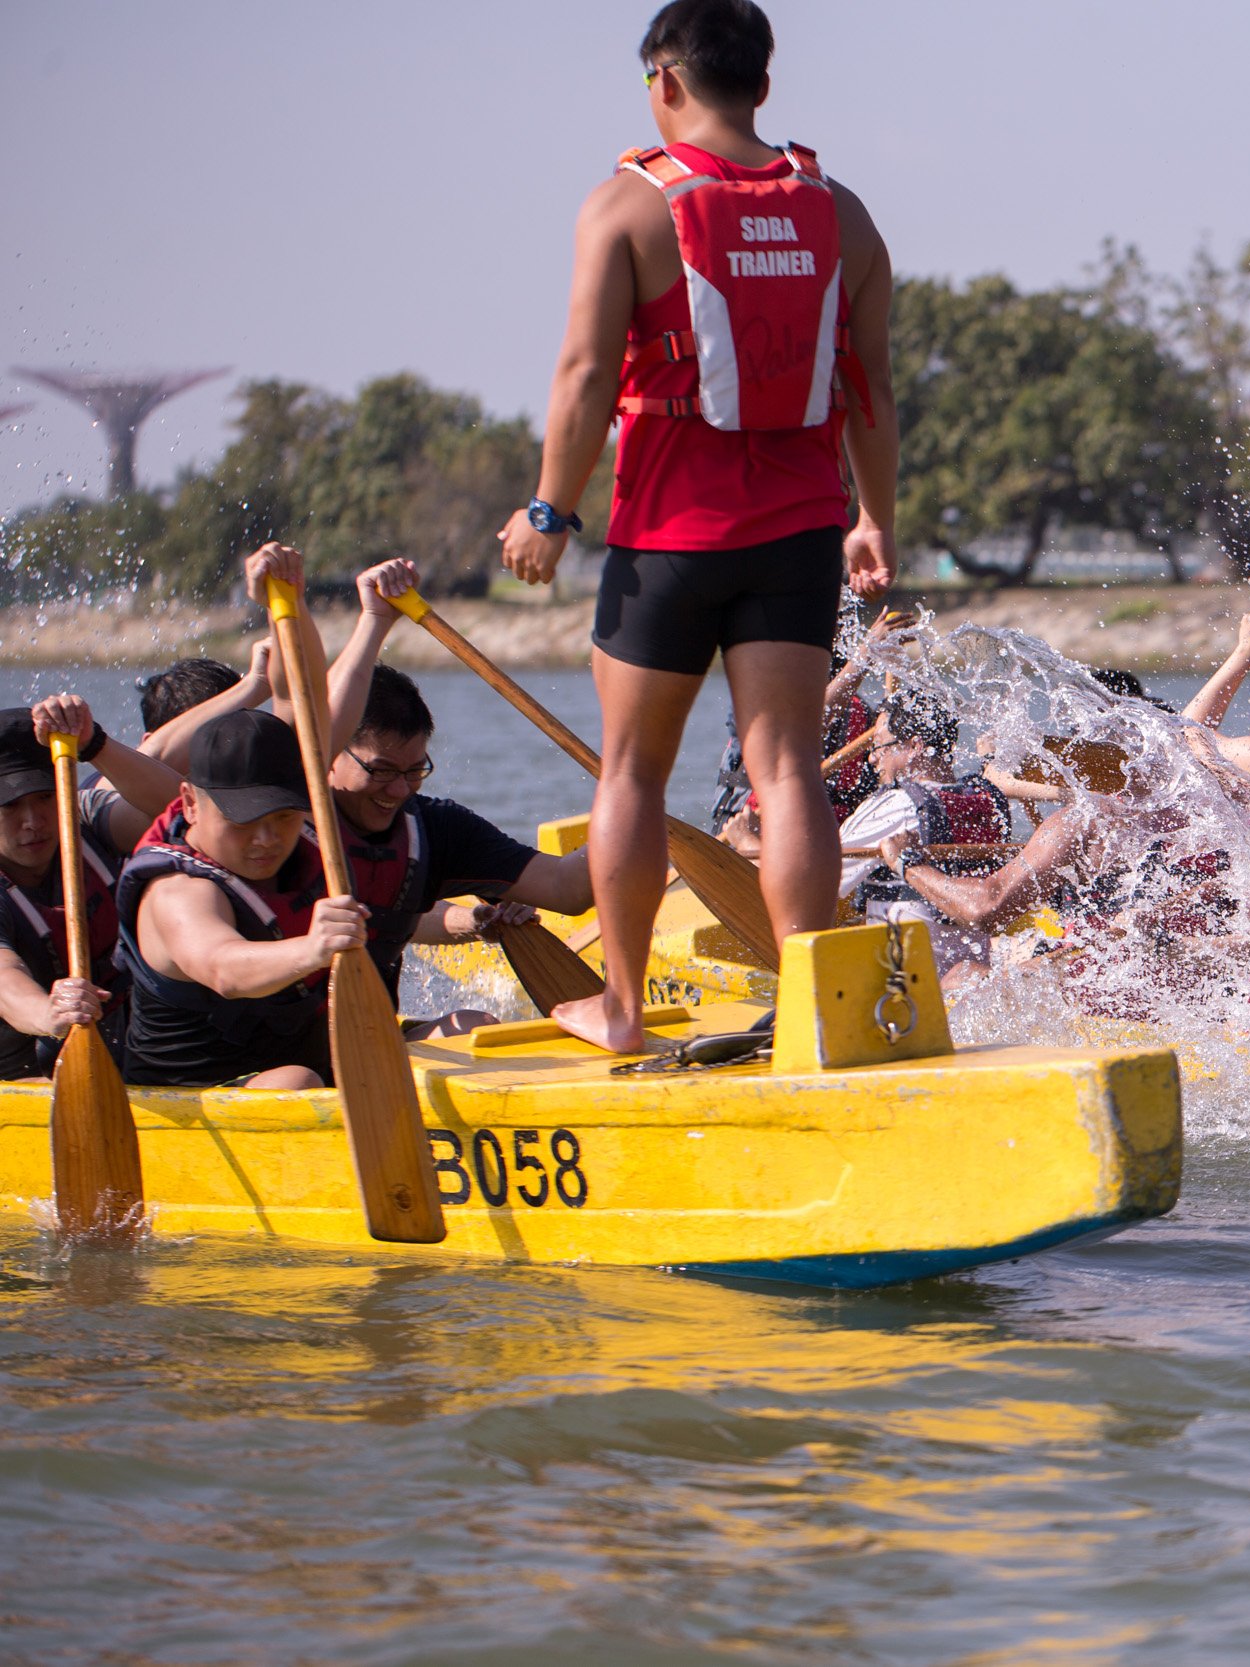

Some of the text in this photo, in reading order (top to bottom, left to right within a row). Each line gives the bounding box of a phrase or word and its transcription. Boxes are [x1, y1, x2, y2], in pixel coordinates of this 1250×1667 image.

[740, 216, 799, 242] SDBA
[726, 250, 816, 277] TRAINER
[427, 1128, 588, 1208] B058
